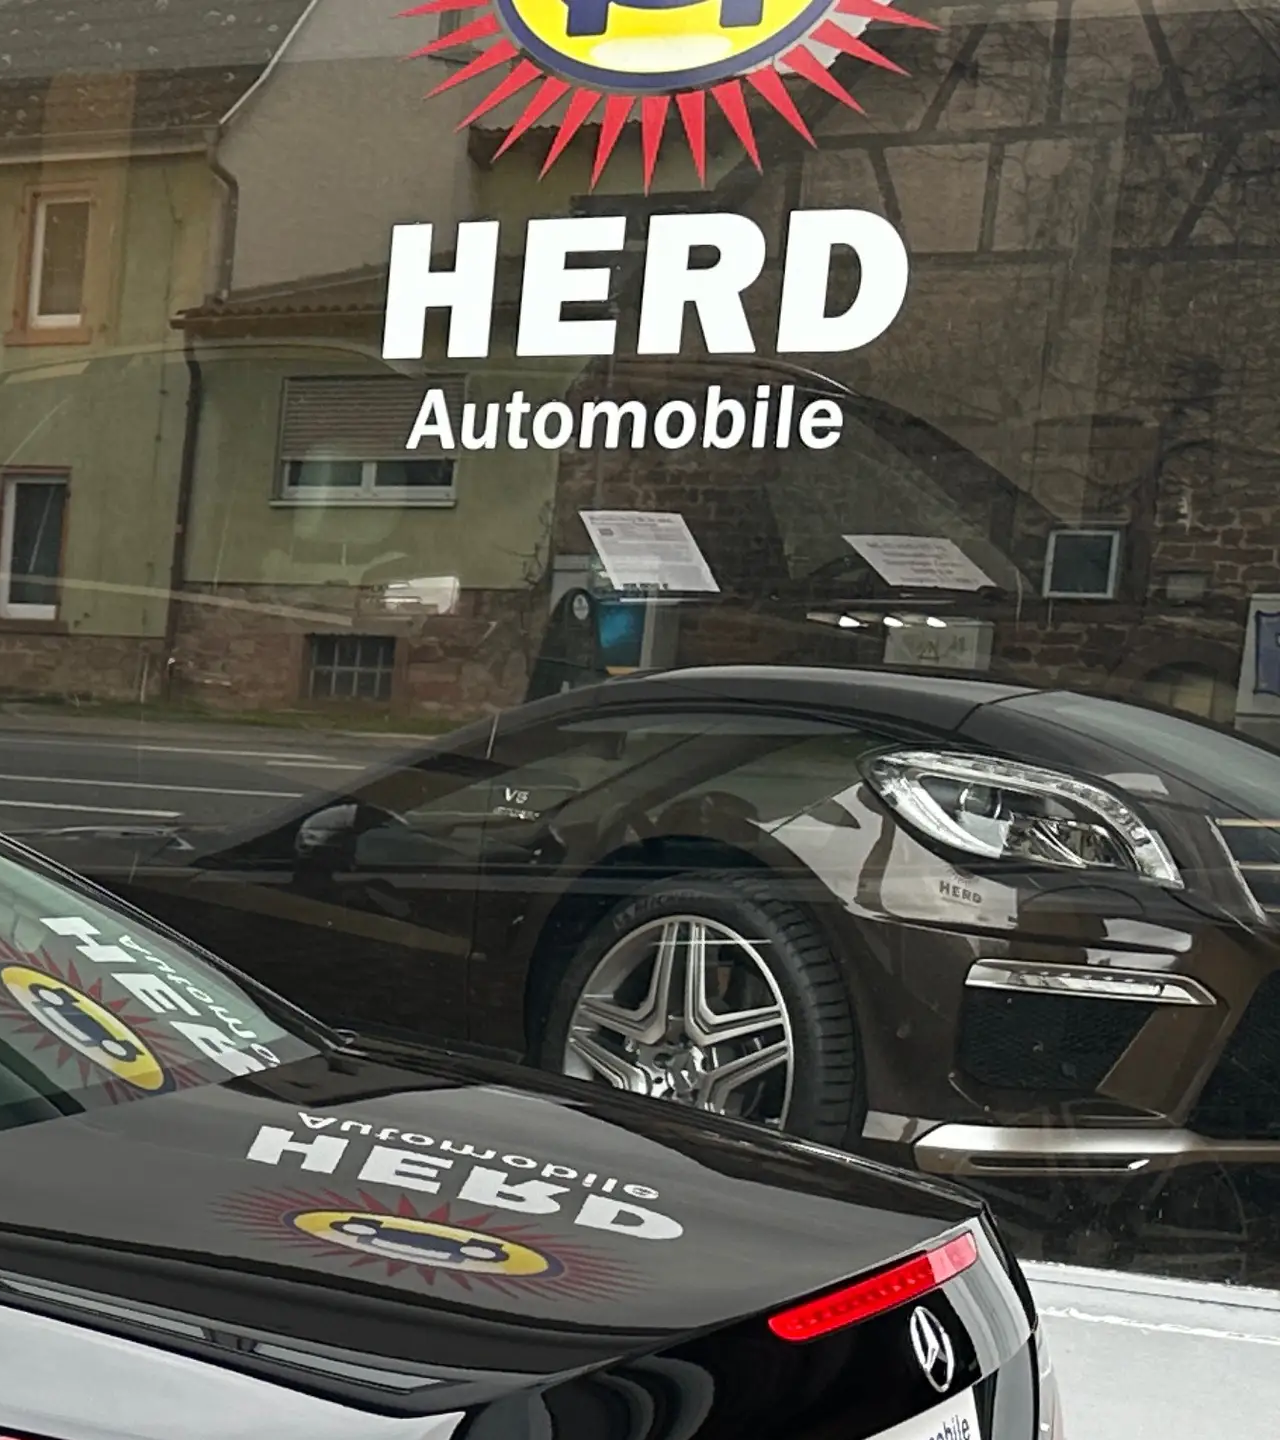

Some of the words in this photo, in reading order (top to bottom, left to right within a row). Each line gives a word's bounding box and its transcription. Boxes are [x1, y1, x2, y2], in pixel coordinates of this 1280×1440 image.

[381, 208, 910, 360] HERD
[405, 384, 845, 451] Automobile
[939, 880, 982, 904] HERD
